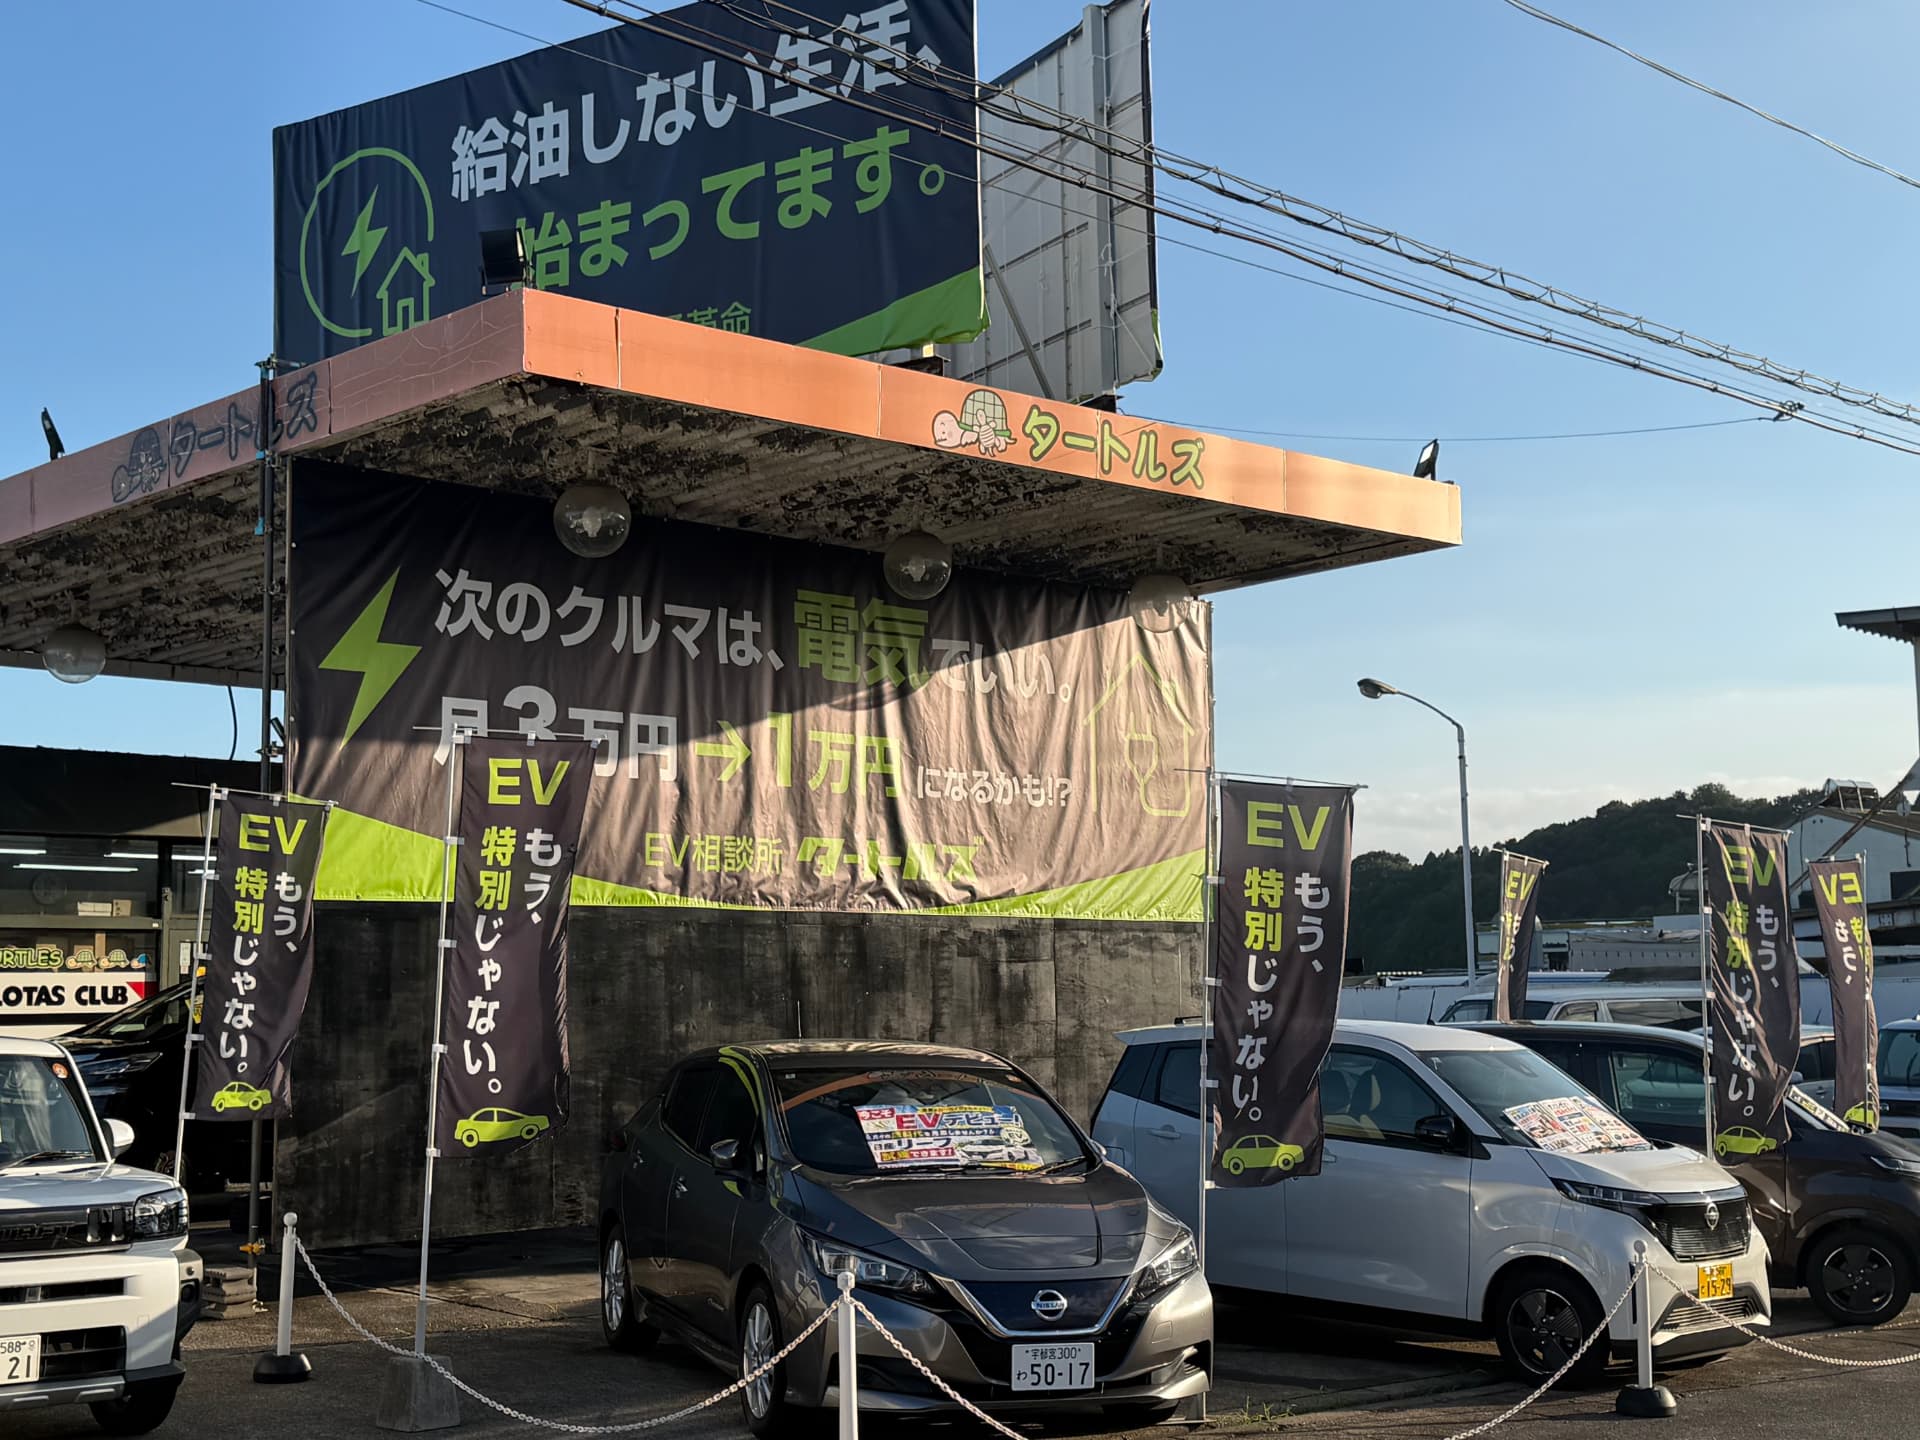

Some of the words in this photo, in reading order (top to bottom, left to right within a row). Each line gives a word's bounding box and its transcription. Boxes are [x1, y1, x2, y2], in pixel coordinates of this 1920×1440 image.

[1022, 404, 1205, 488] タートルズ
[434, 568, 1072, 704] 次のクルマは、電気でいい。
[487, 758, 570, 806] EV
[239, 813, 308, 855] EV
[1246, 800, 1331, 852] EV
[523, 827, 561, 925] もう、
[1506, 870, 1536, 901] EV
[1724, 845, 1776, 887] EV
[273, 872, 302, 953] もう、
[1293, 872, 1330, 973] もう、
[0, 948, 63, 968] RTLES
[219, 866, 268, 1074] 特別じゃない。
[463, 826, 517, 1095] 特別じゃない。
[0, 985, 65, 1006] OTAS
[75, 985, 128, 1005] CLUB
[1231, 866, 1285, 1122] 特別じゃない。
[1016, 1370, 1028, 1381] わ
[1030, 1362, 1090, 1386] 50-17
